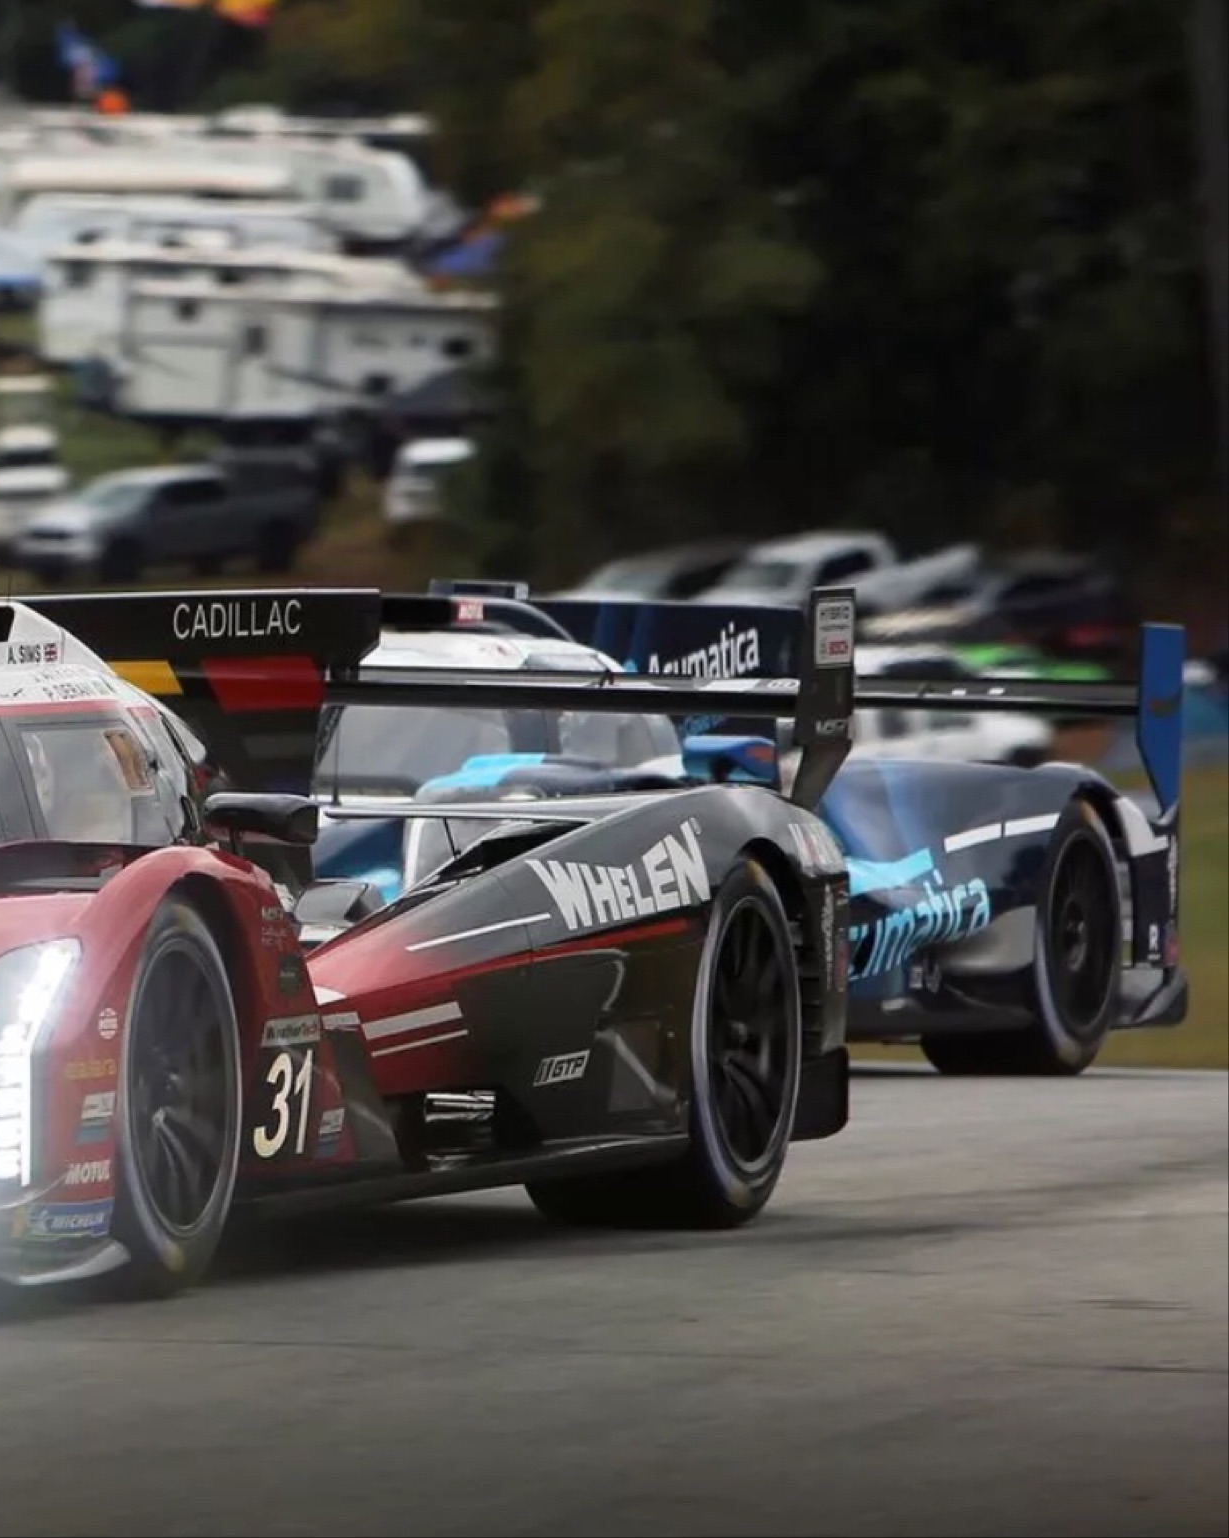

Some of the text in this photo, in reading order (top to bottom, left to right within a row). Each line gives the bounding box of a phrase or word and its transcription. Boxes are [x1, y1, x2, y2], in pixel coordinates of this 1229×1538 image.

[173, 599, 302, 640] CADILLAC
[525, 819, 711, 931] WHELEN
[253, 1049, 313, 1158] 31
[65, 1160, 111, 1185] MOTUL
